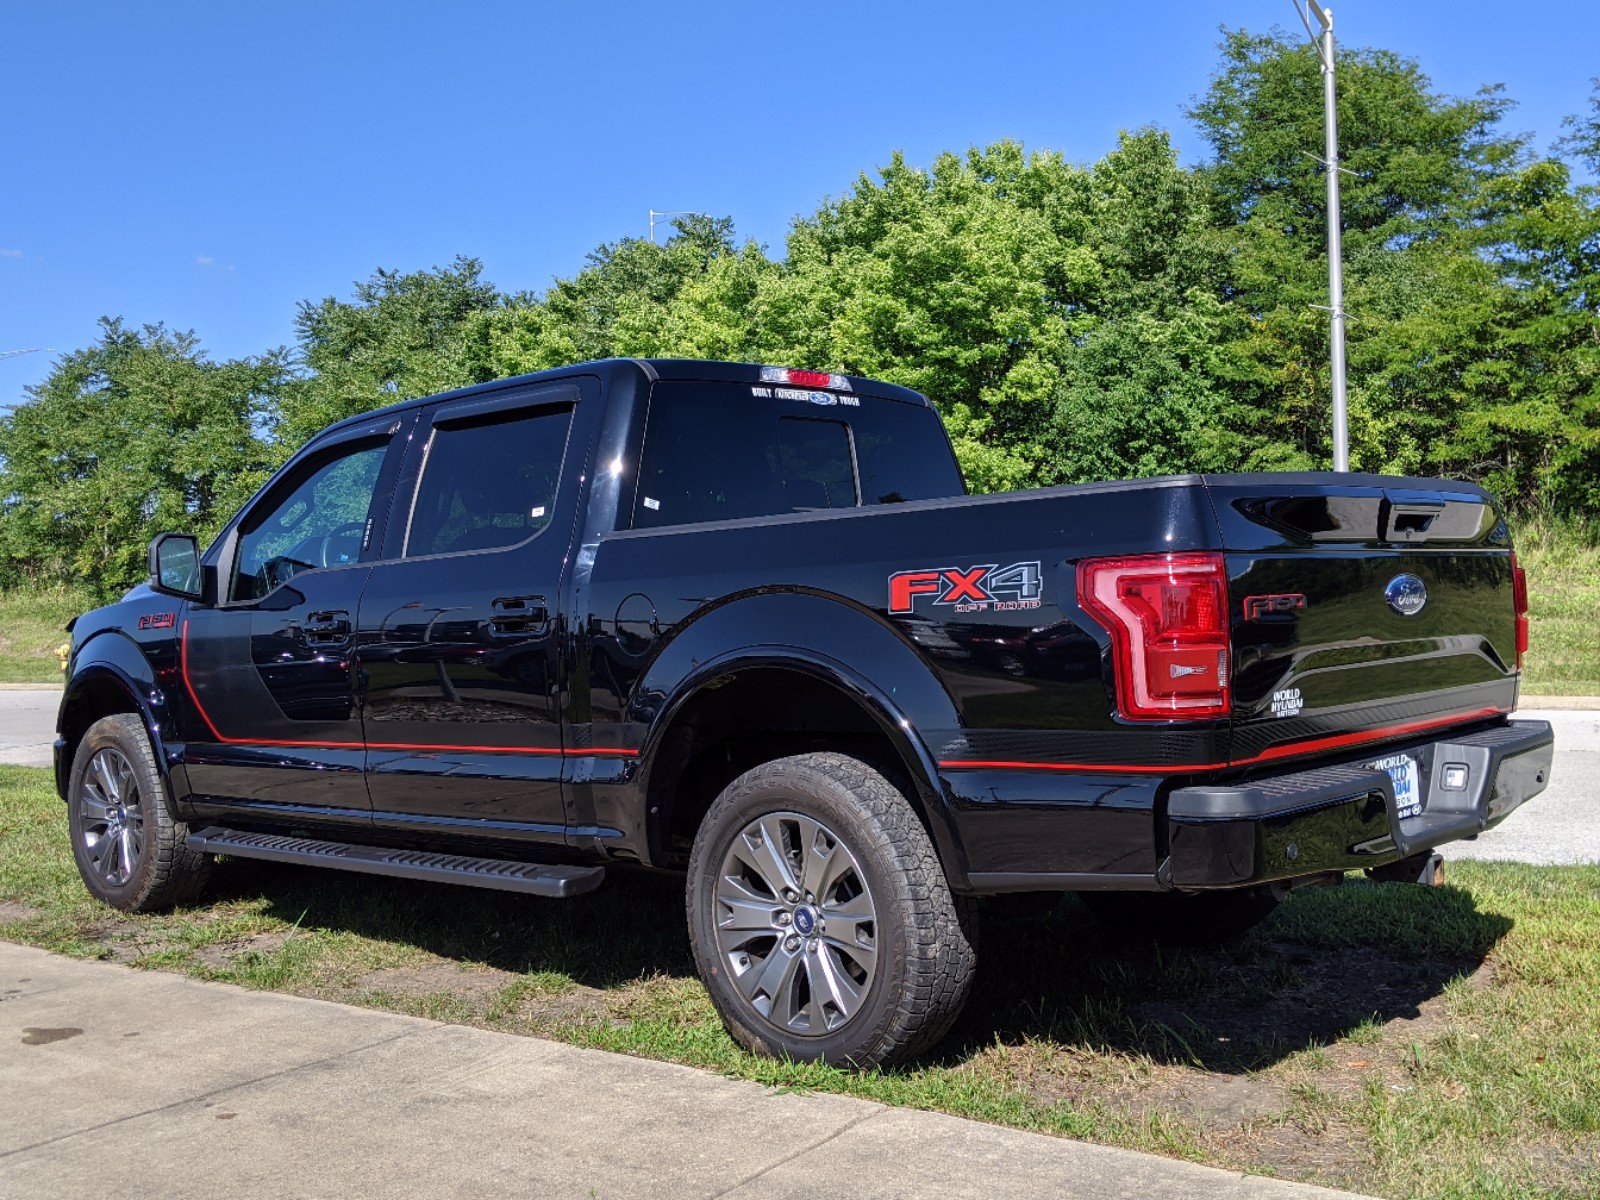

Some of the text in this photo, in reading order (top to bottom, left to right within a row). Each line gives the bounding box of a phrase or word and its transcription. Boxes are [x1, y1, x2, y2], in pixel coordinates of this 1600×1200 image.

[888, 562, 1042, 614] FX4
[954, 600, 1042, 613] OFF ROAD
[1273, 688, 1301, 702] WORLD
[1271, 698, 1304, 713] HYUNDAI
[1375, 754, 1407, 771] WORLD
